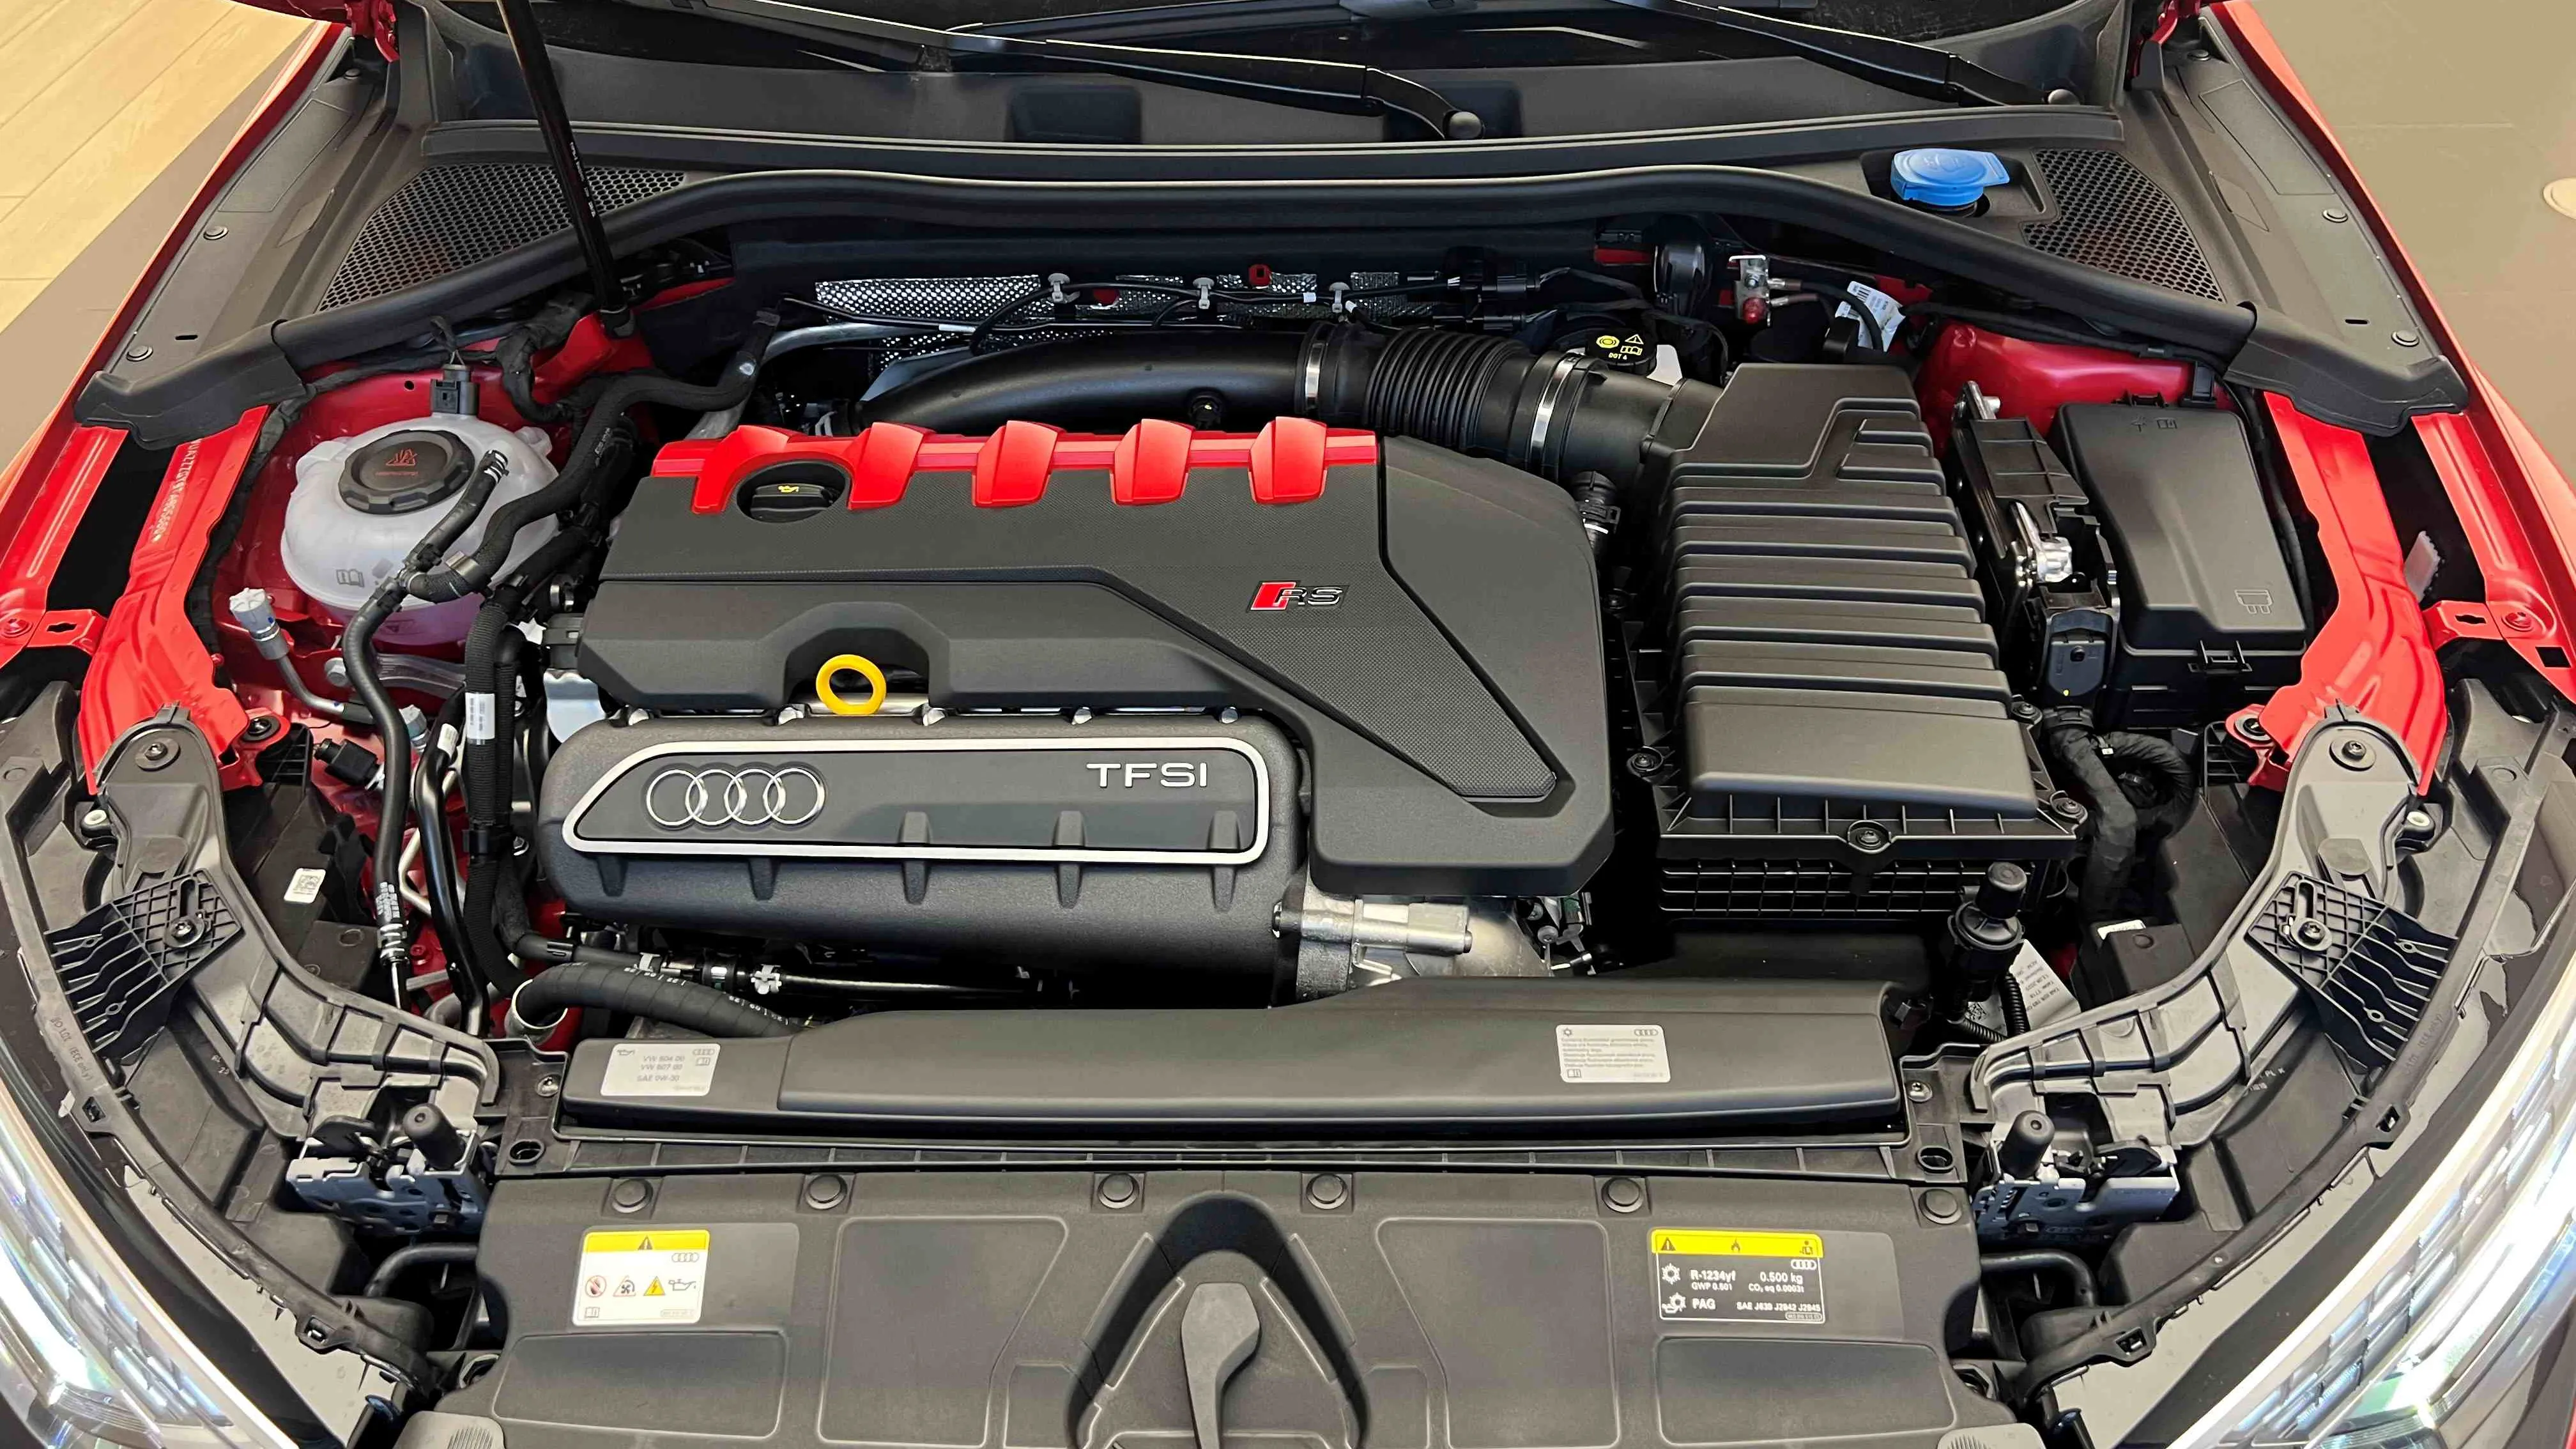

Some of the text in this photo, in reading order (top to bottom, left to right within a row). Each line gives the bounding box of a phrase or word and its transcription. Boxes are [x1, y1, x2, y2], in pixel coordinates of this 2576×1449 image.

[1271, 586, 1342, 606] RS
[1086, 762, 1208, 788] TFSI
[1690, 1269, 1803, 1285] R-1234yf 0.500 kg
[1691, 1282, 1711, 1290] GWP
[1692, 1298, 1716, 1310] PAG
[1736, 1301, 1752, 1310] SAE
